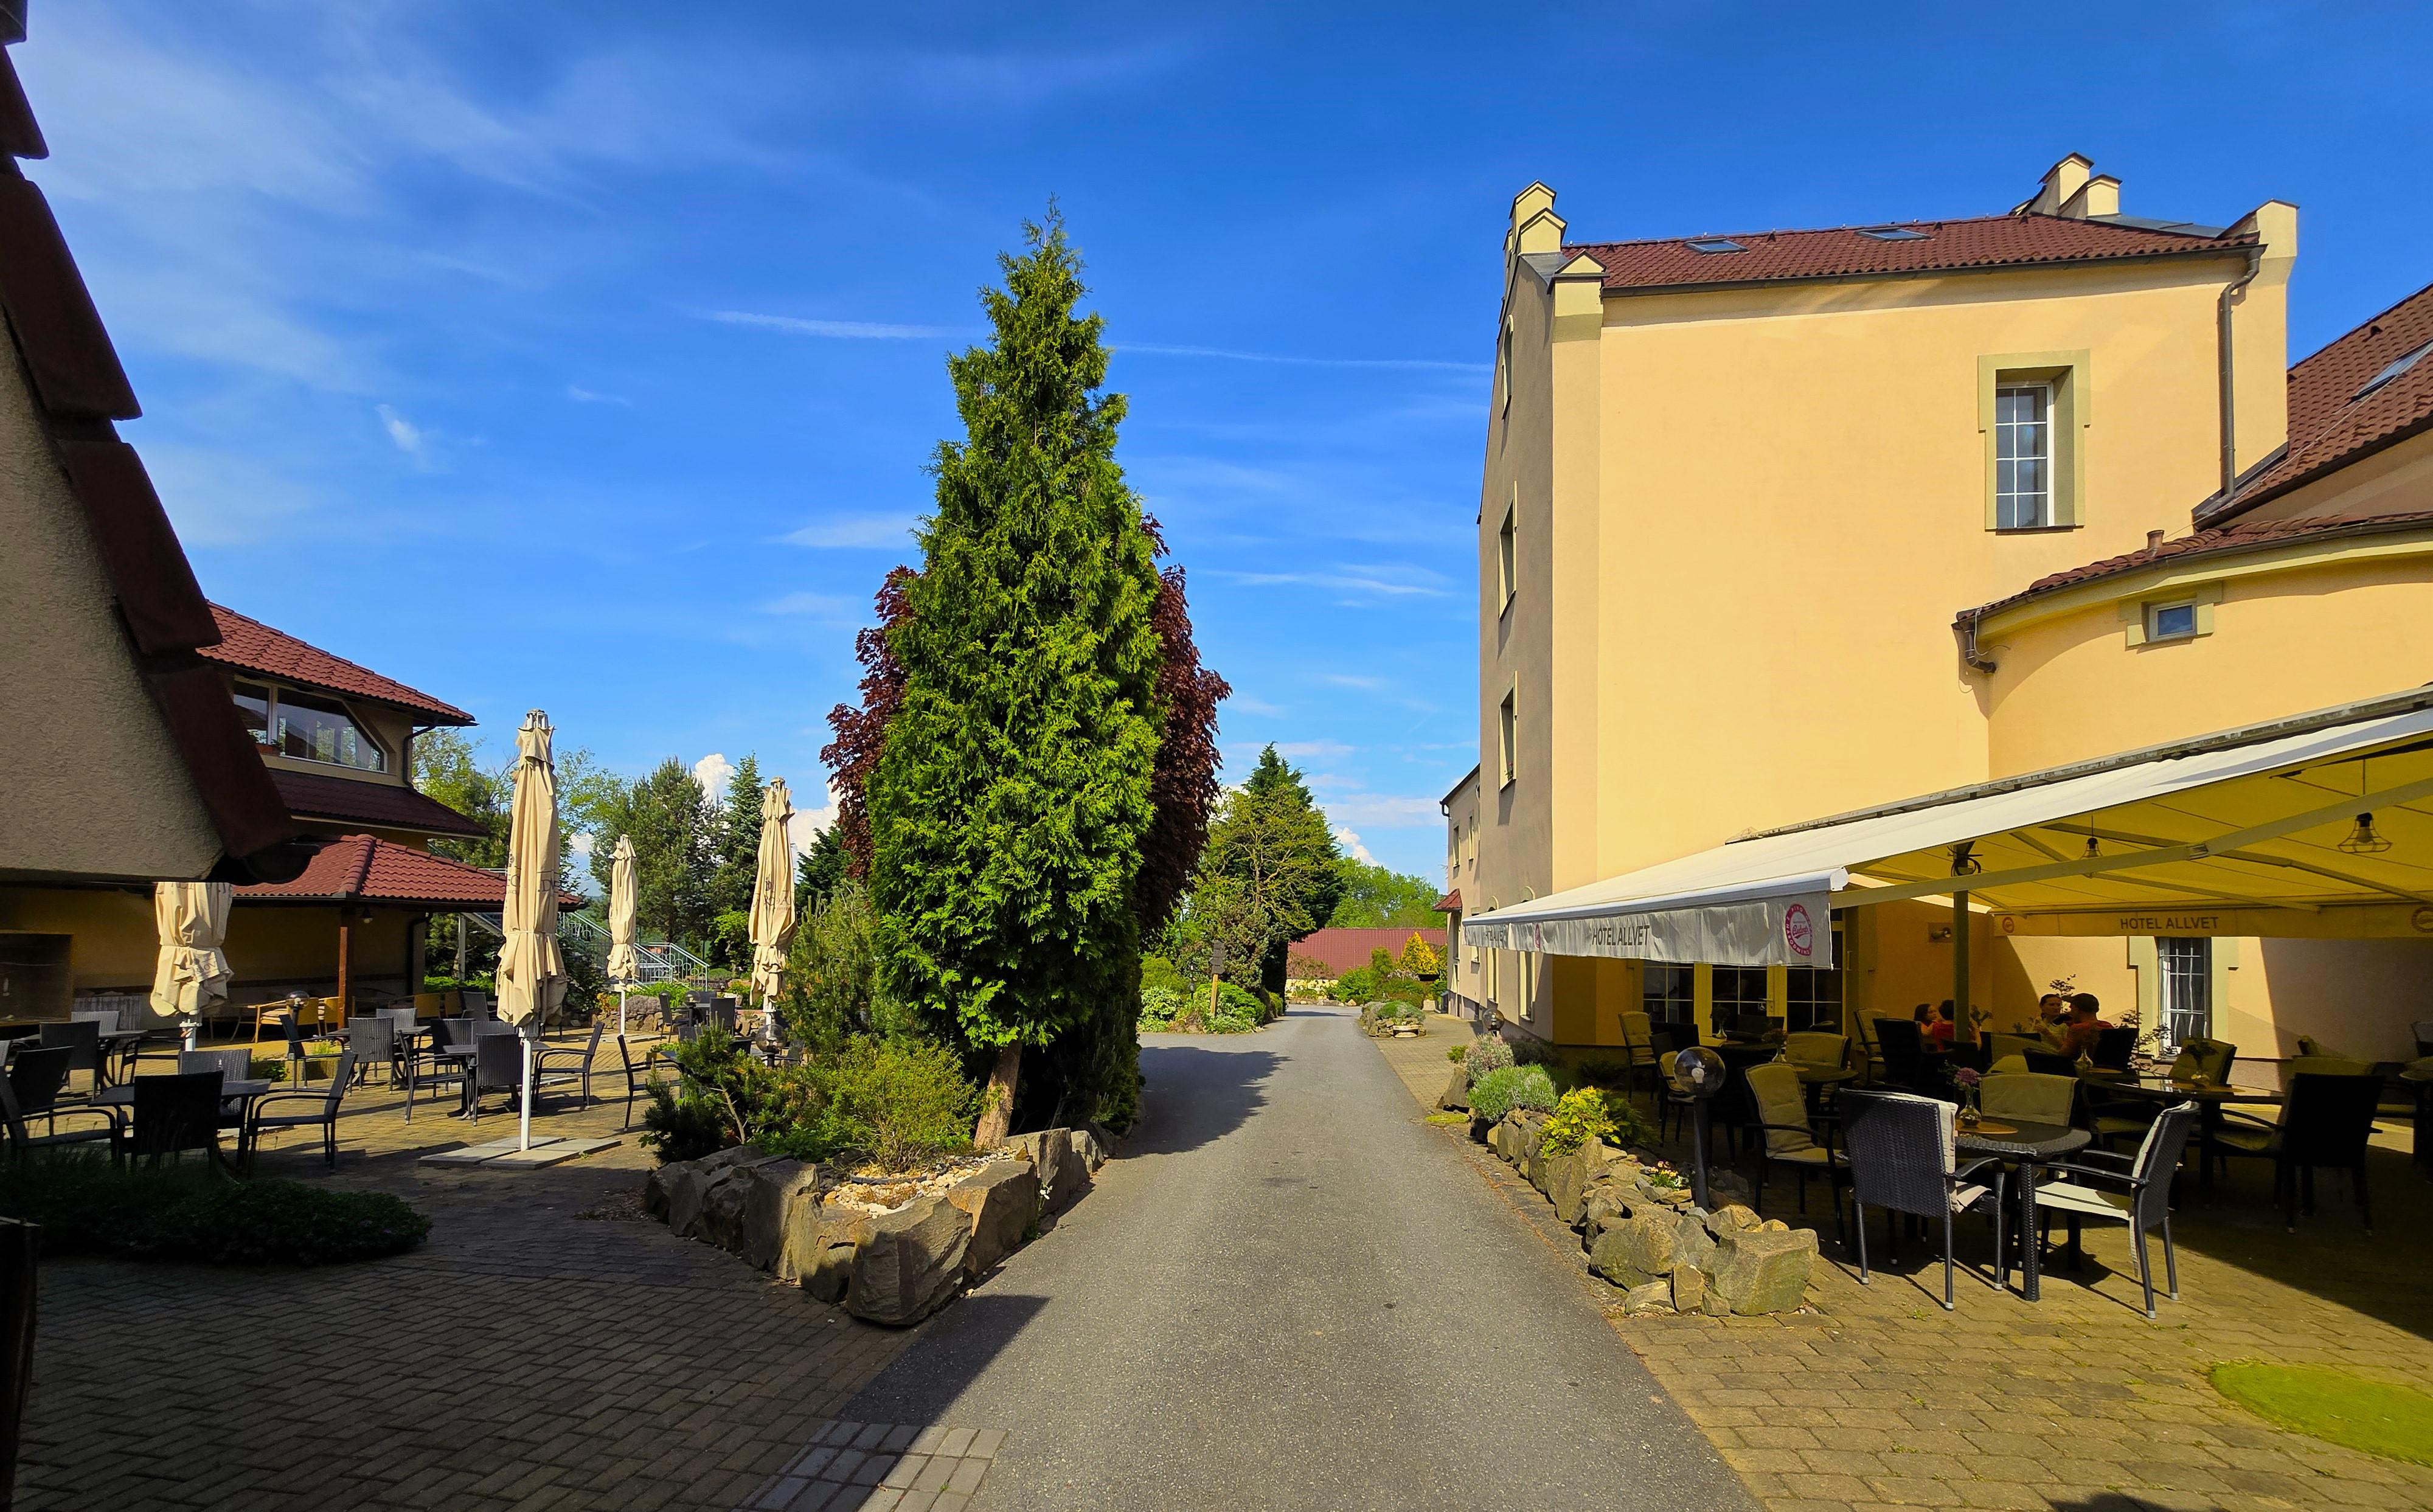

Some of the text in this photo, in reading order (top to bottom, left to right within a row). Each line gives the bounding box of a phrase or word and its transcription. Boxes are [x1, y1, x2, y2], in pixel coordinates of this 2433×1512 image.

[2120, 917, 2219, 929] HOTEL ALLVET
[1592, 925, 1650, 946] HOTEL ALLVET
